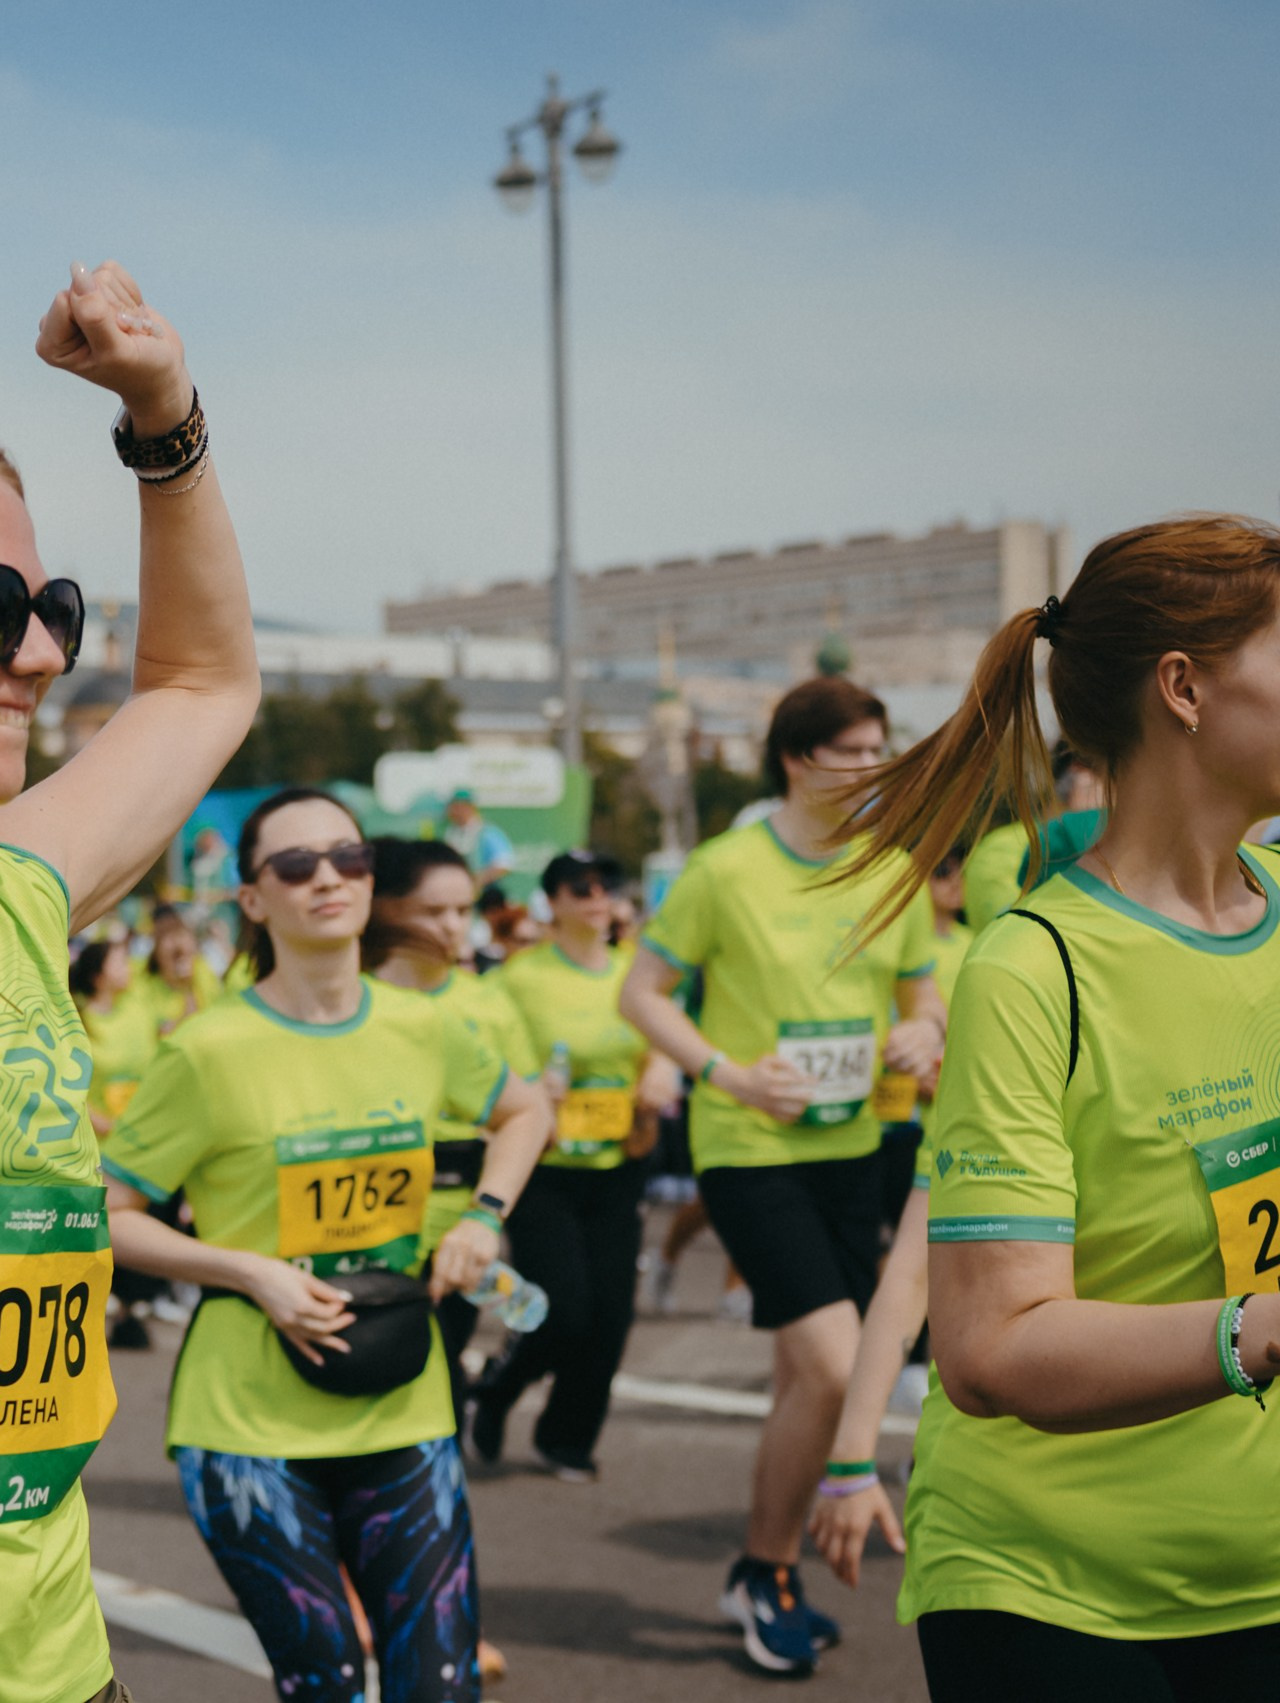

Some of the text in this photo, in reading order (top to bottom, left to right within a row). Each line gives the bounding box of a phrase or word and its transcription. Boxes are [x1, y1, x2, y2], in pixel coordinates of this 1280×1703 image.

[1166, 1068, 1254, 1106] зелёный
[1157, 1096, 1252, 1129] марафон
[1241, 1142, 1269, 1161] СБЕР
[968, 1163, 1026, 1176] будущее
[306, 1168, 411, 1220] 1762
[5, 1220, 44, 1231] марафон
